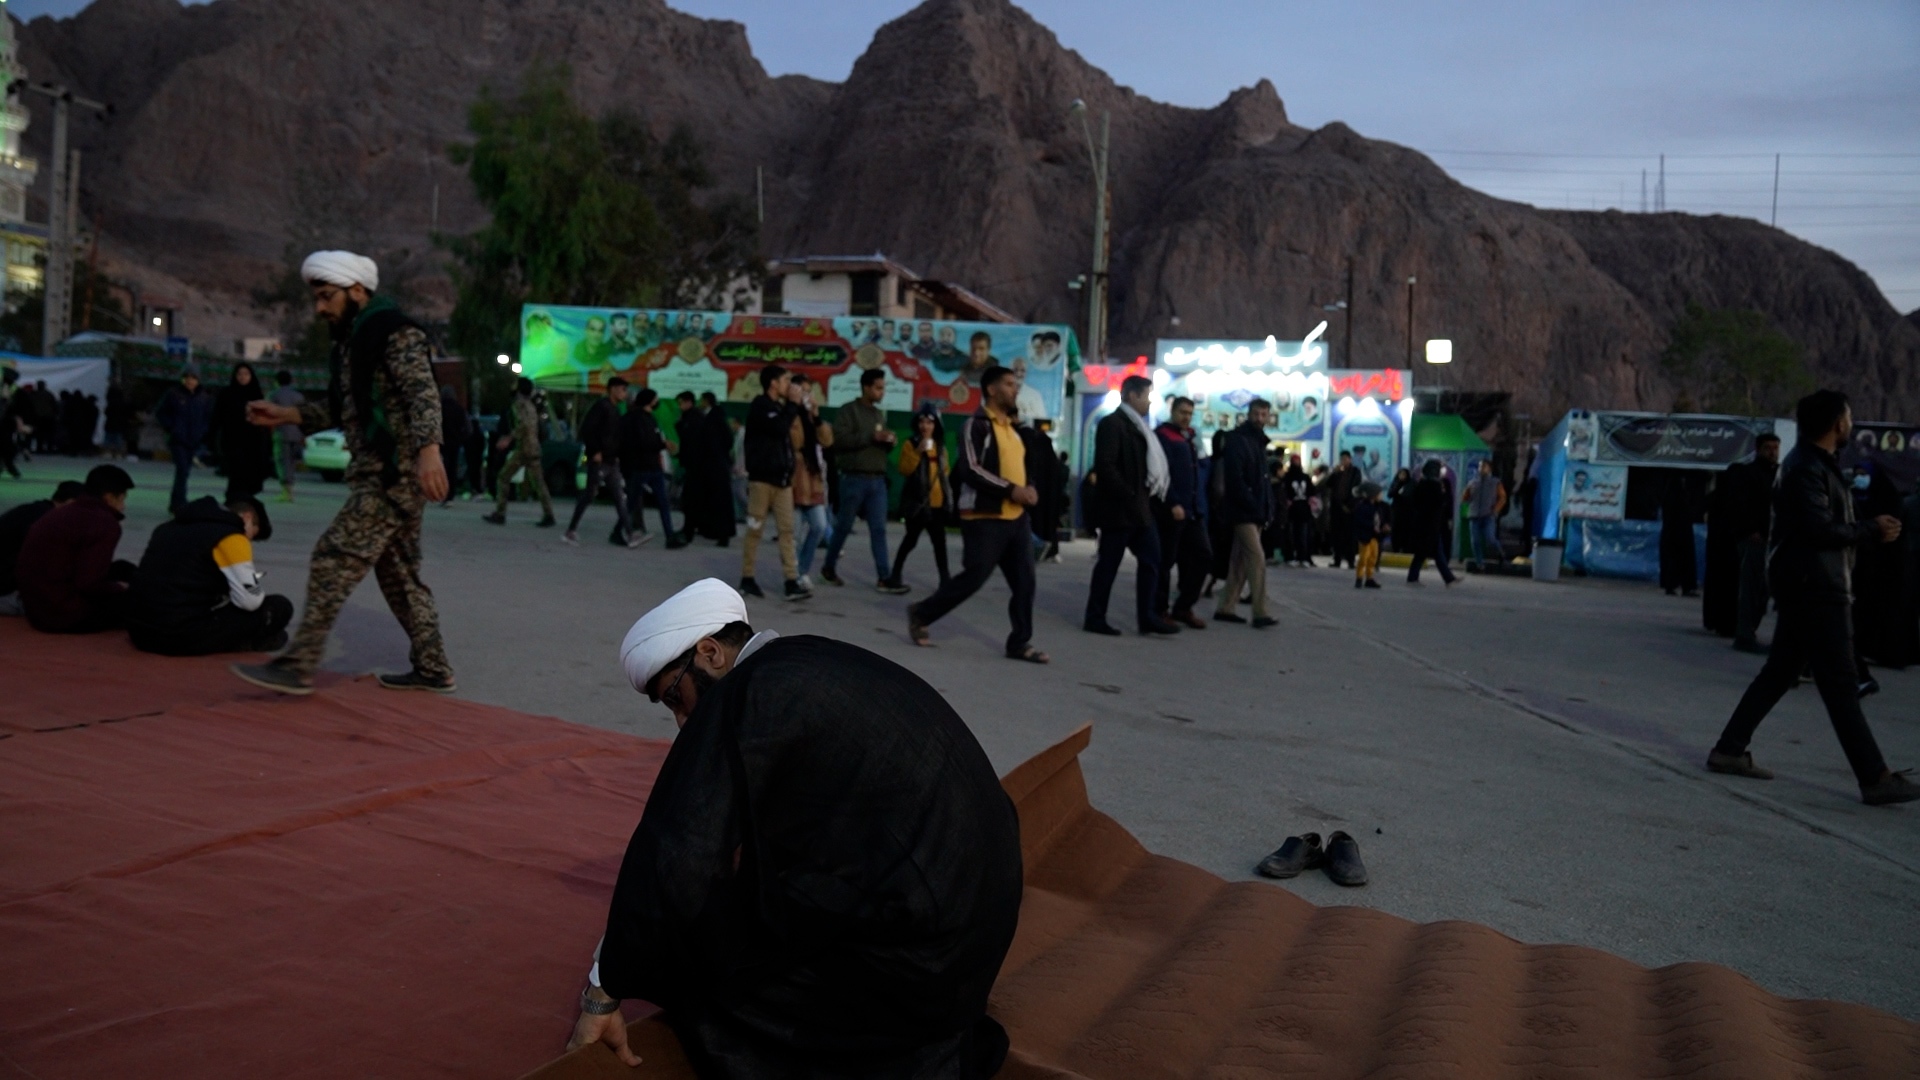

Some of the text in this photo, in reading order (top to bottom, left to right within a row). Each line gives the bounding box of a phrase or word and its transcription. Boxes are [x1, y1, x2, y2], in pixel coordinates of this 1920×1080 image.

[719, 344, 838, 365] موکب شهدای مقاومت
